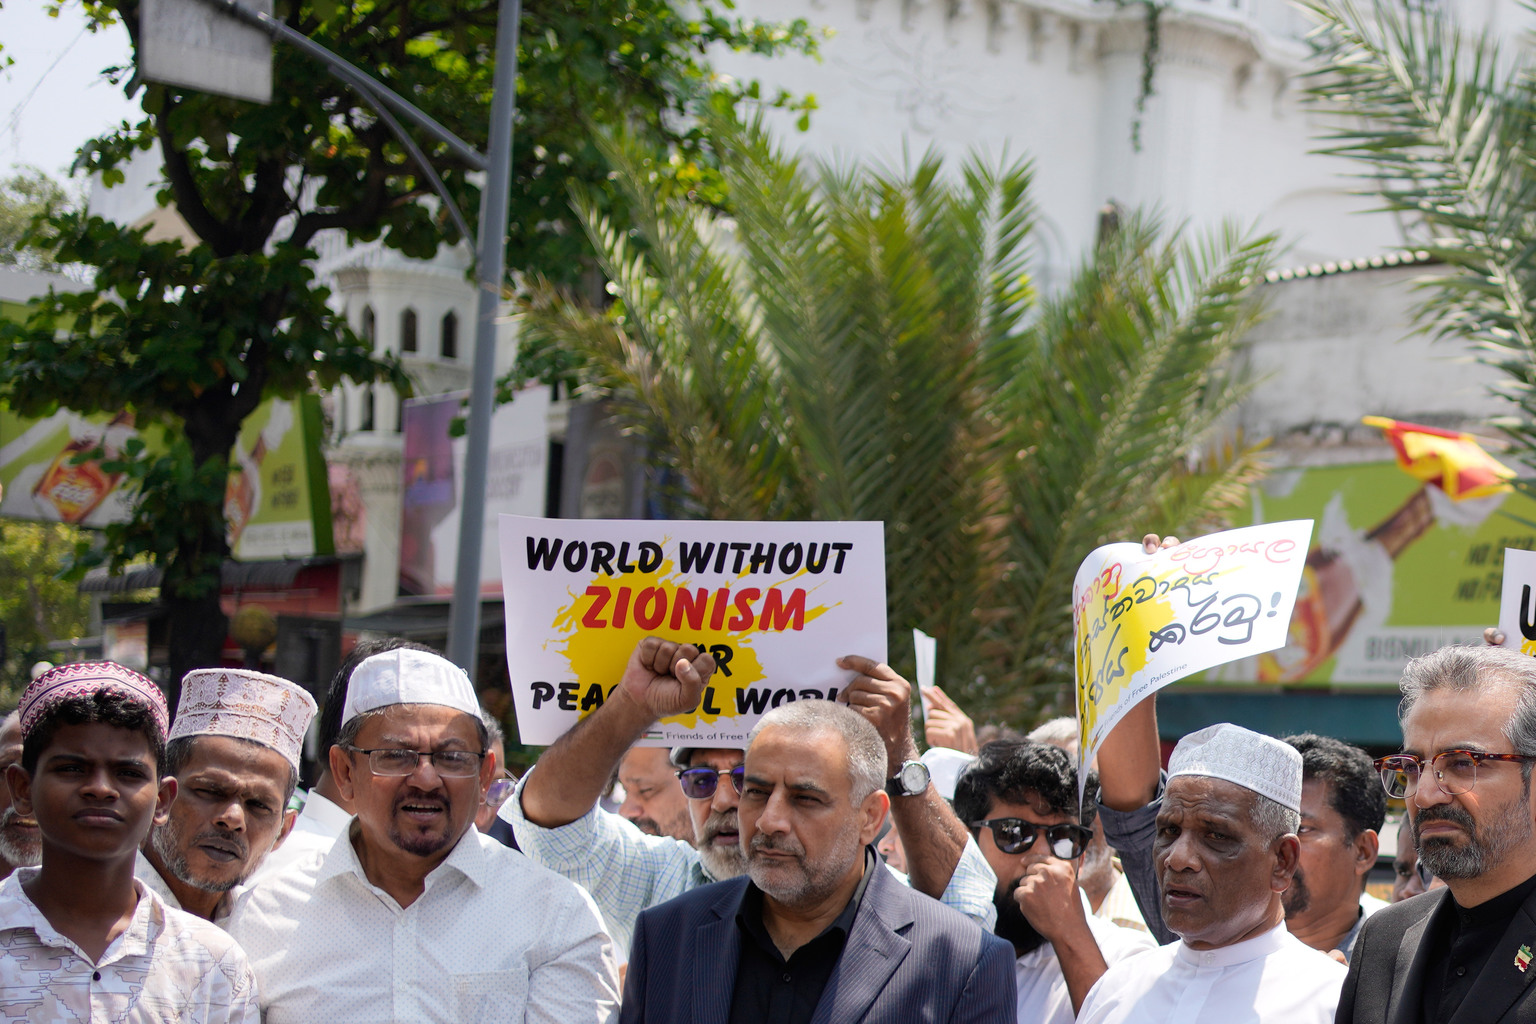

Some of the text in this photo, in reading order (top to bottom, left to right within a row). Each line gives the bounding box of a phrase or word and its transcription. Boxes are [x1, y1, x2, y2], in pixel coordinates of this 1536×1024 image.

[526, 536, 854, 576] WORLD WITHOUT
[581, 586, 807, 632] ZIONISM
[1149, 663, 1188, 686] Palestine
[665, 730, 704, 741] Friends
[706, 731, 717, 741] of
[719, 731, 744, 741] Free
